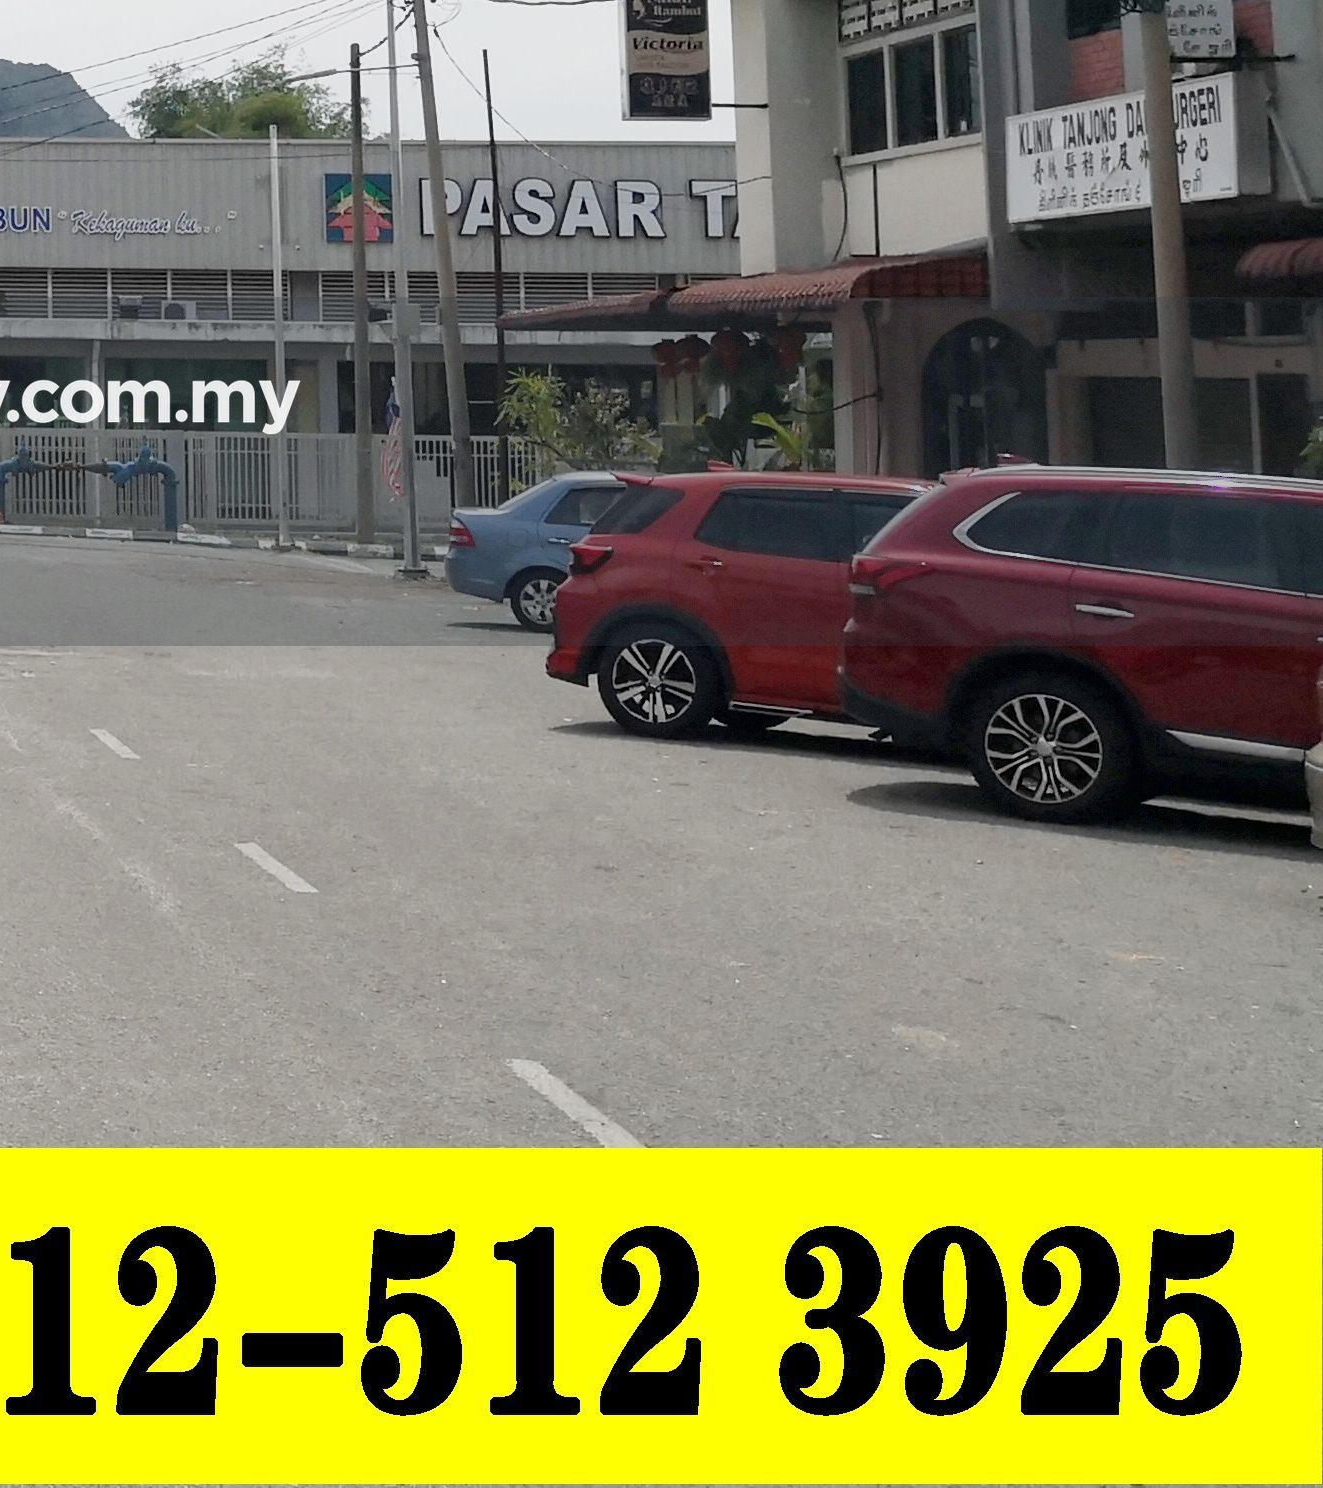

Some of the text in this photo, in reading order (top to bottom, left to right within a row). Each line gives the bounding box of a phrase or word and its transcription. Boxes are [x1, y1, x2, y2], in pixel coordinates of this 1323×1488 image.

[632, 36, 704, 51] Victoria
[1018, 85, 1222, 156] KLINIK TANJONG DA URGERI
[419, 177, 740, 240] PASAR T
